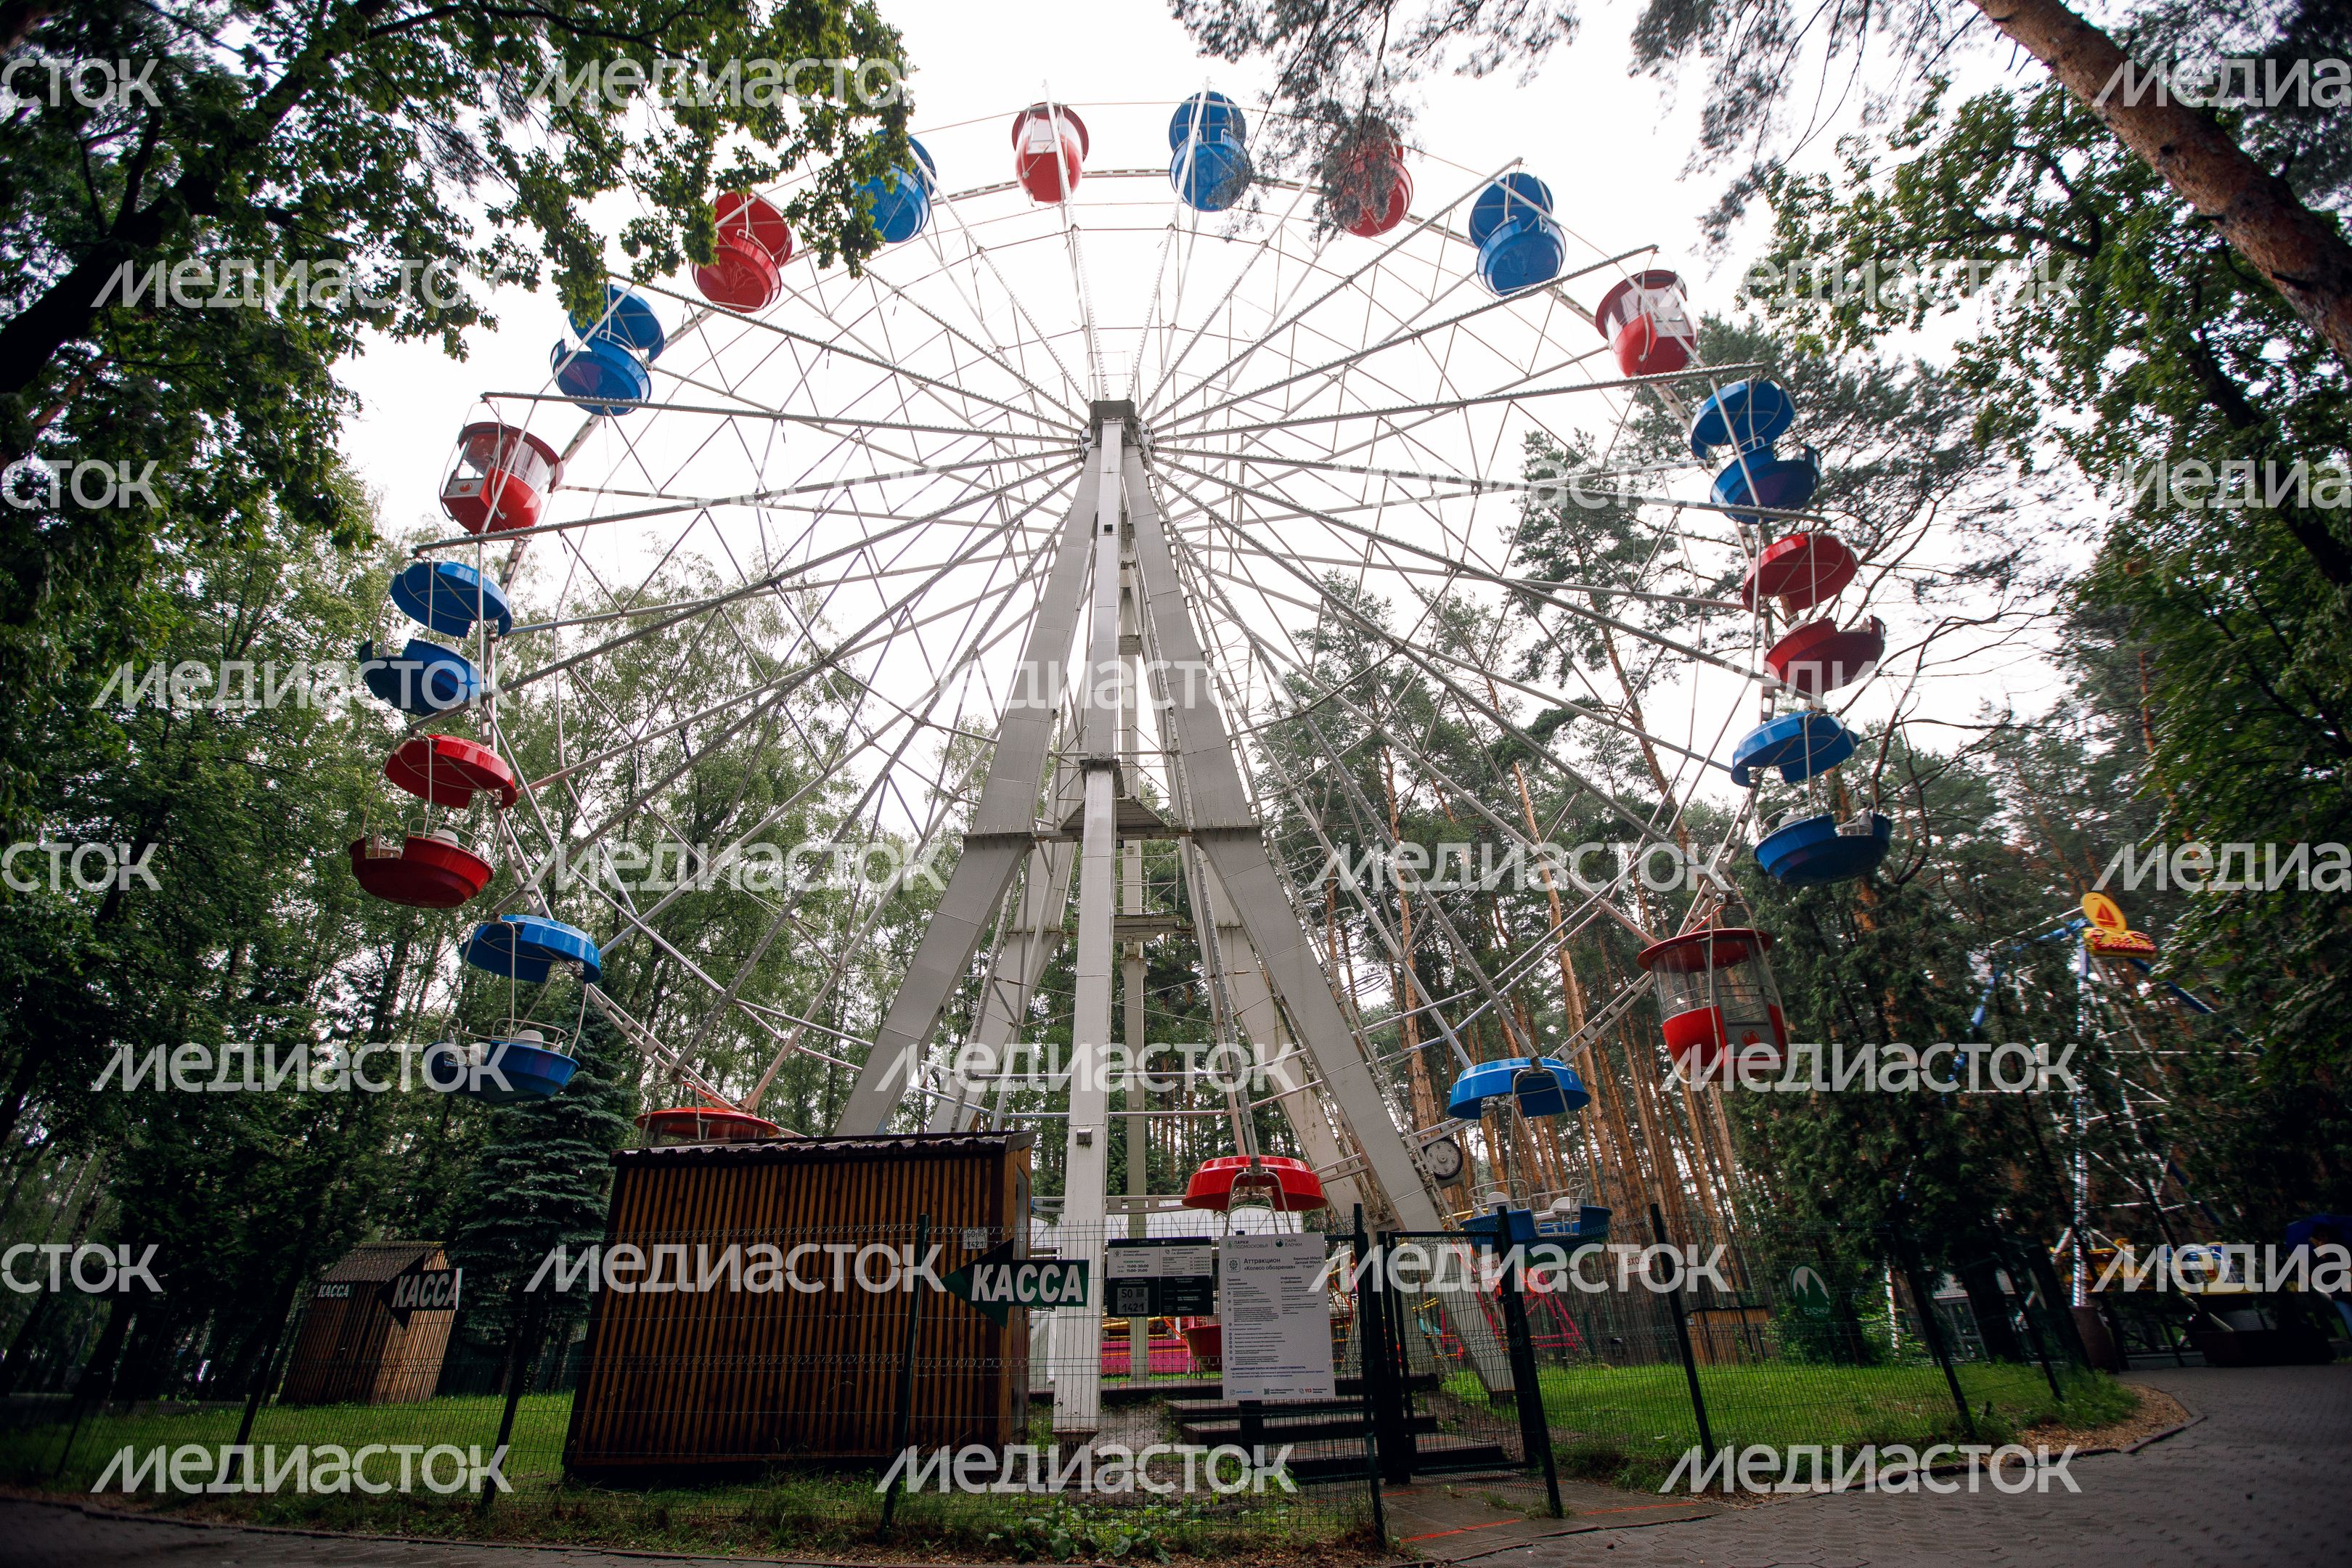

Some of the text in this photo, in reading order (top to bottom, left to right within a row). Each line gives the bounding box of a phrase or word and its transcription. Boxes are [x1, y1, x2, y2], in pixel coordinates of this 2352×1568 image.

[971, 1264, 1083, 1302] КАССА
[317, 1284, 350, 1297] КАССА
[391, 1273, 457, 1307] КАССА
[1122, 1289, 1132, 1298] 50
[1122, 1303, 1144, 1312] 1421
